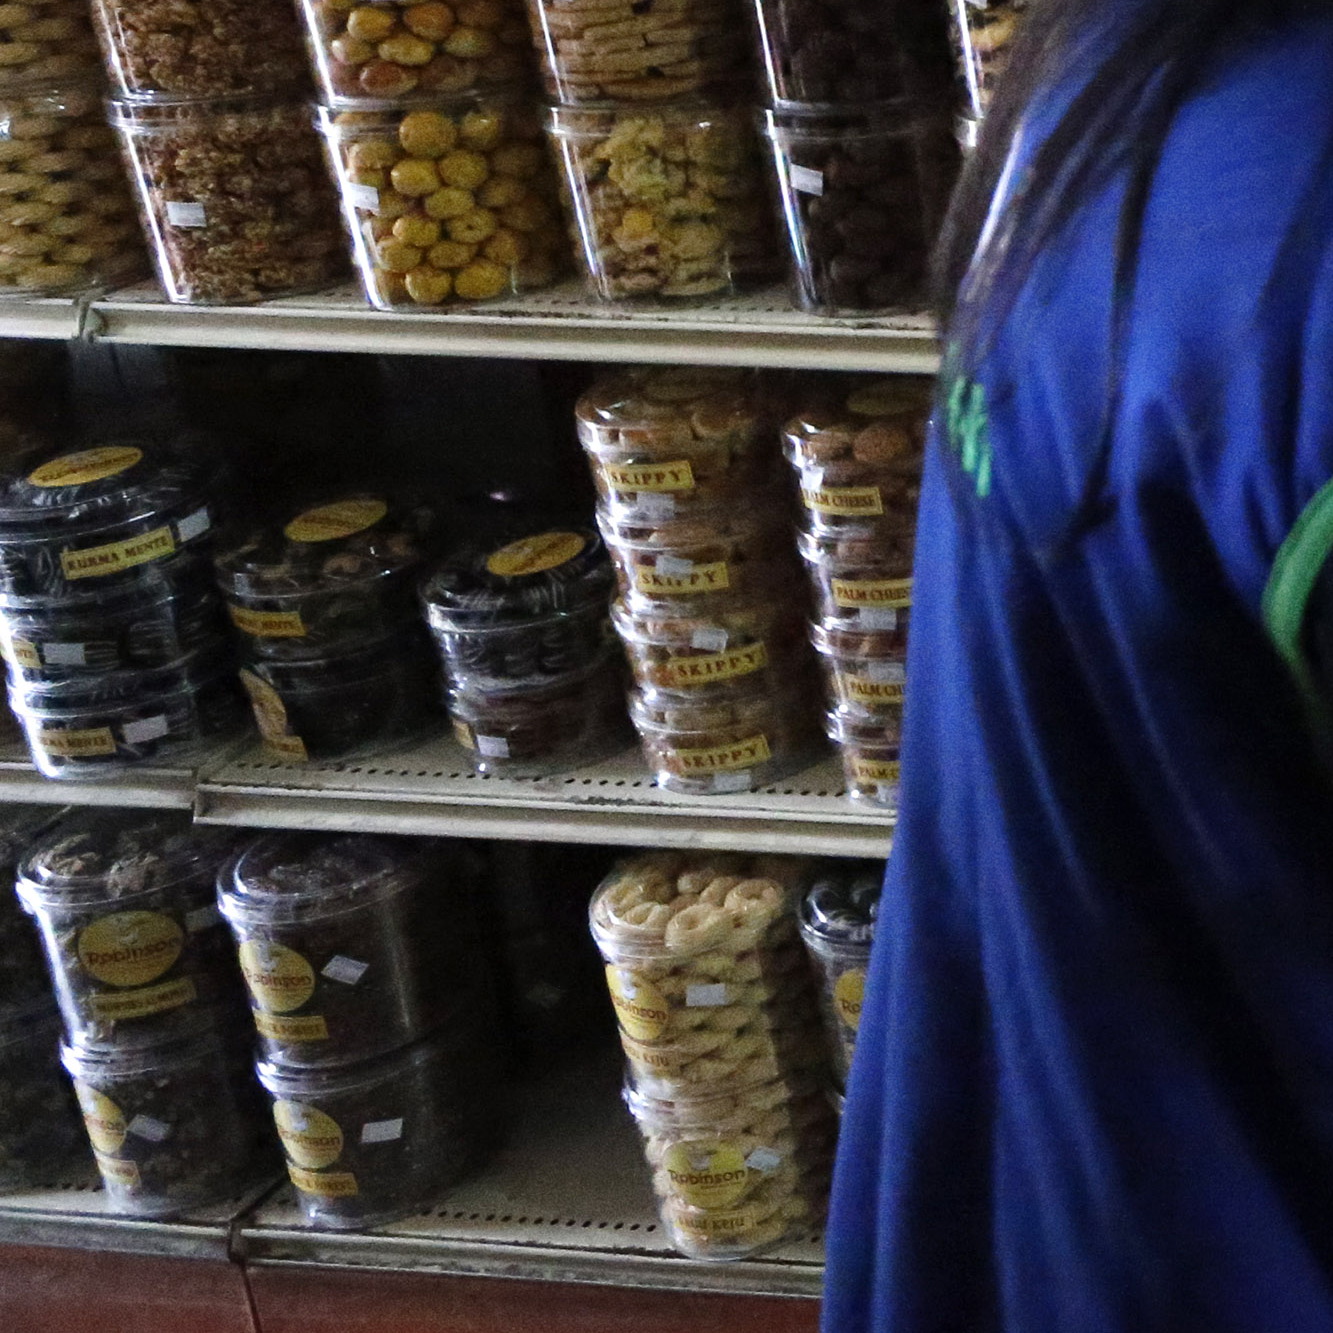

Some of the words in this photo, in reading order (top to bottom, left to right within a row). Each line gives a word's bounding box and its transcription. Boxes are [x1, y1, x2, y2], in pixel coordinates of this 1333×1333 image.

[610, 468, 682, 485] SKIPPY
[67, 549, 121, 572] KURMA
[123, 533, 169, 558] MENTE
[838, 585, 870, 603] PALM
[871, 586, 908, 605] CHEES
[677, 651, 758, 680] SKIPPY
[681, 744, 759, 769] SKIPPY
[666, 1167, 747, 1192] Robinson
